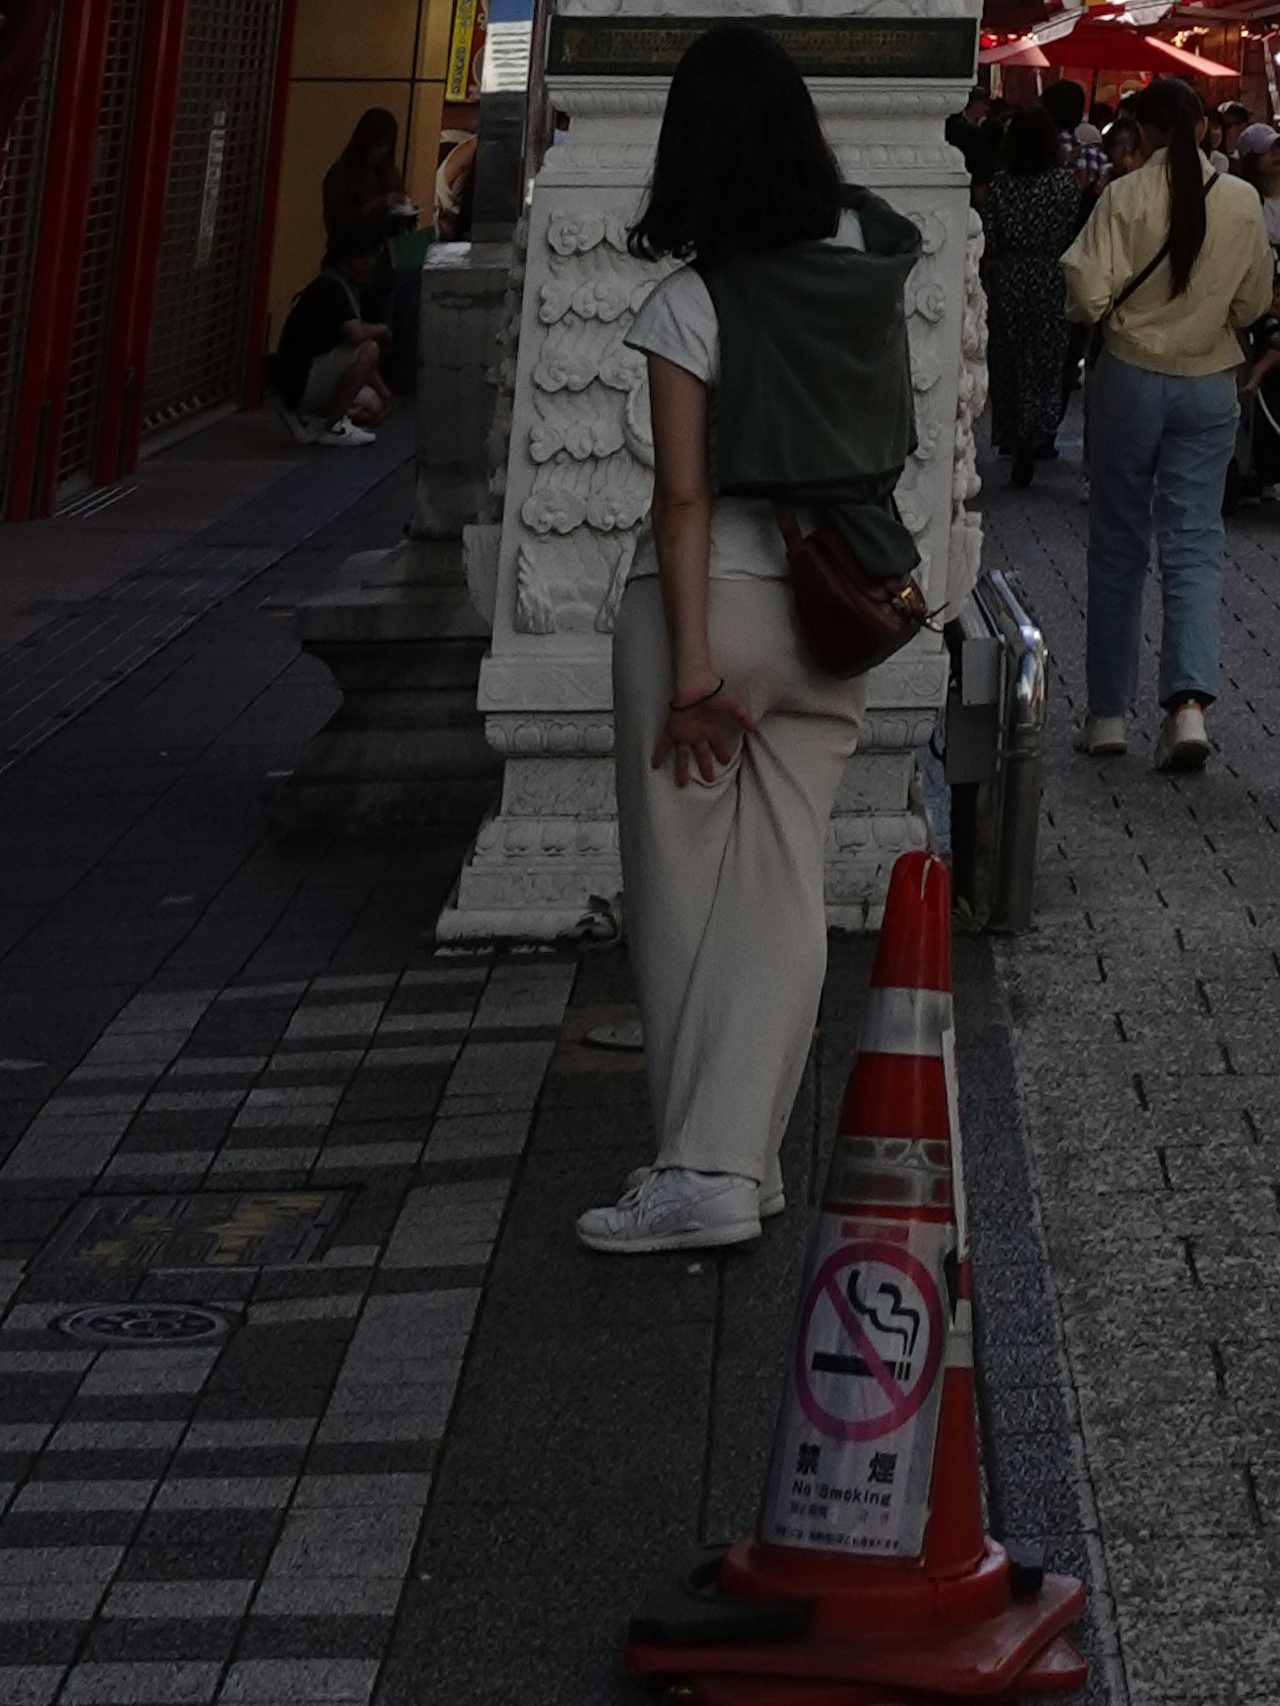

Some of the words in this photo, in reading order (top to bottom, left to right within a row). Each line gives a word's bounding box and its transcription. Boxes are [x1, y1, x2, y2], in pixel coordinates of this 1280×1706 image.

[797, 1441, 898, 1484] 禁煙
[791, 1480, 812, 1497] No
[818, 1483, 892, 1507] Smoking
